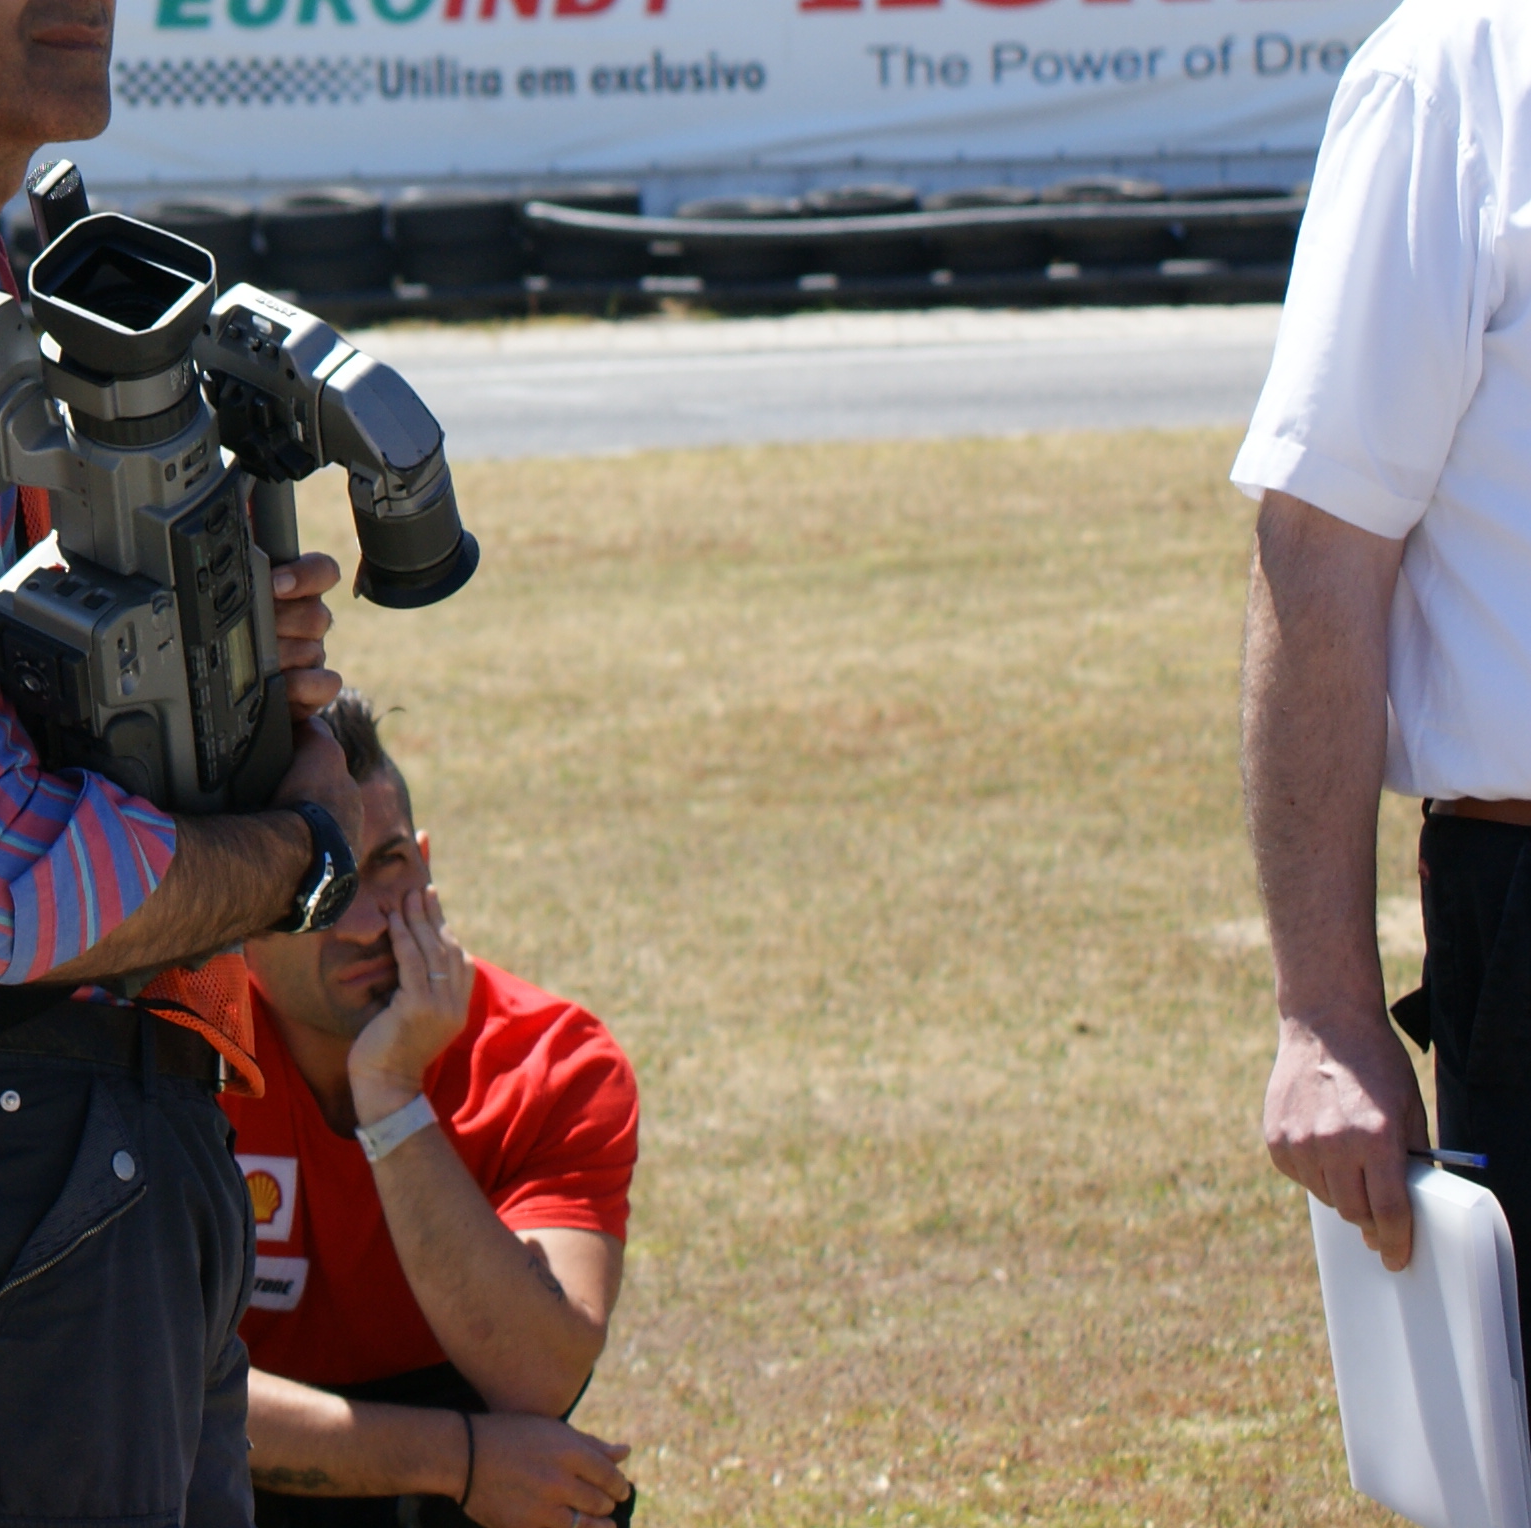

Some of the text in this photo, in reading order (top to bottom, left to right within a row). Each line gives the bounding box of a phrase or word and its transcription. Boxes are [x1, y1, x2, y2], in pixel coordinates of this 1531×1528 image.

[516, 65, 576, 97] em
[589, 49, 766, 95] exclusivo
[868, 33, 1363, 89] The Power of Dre
